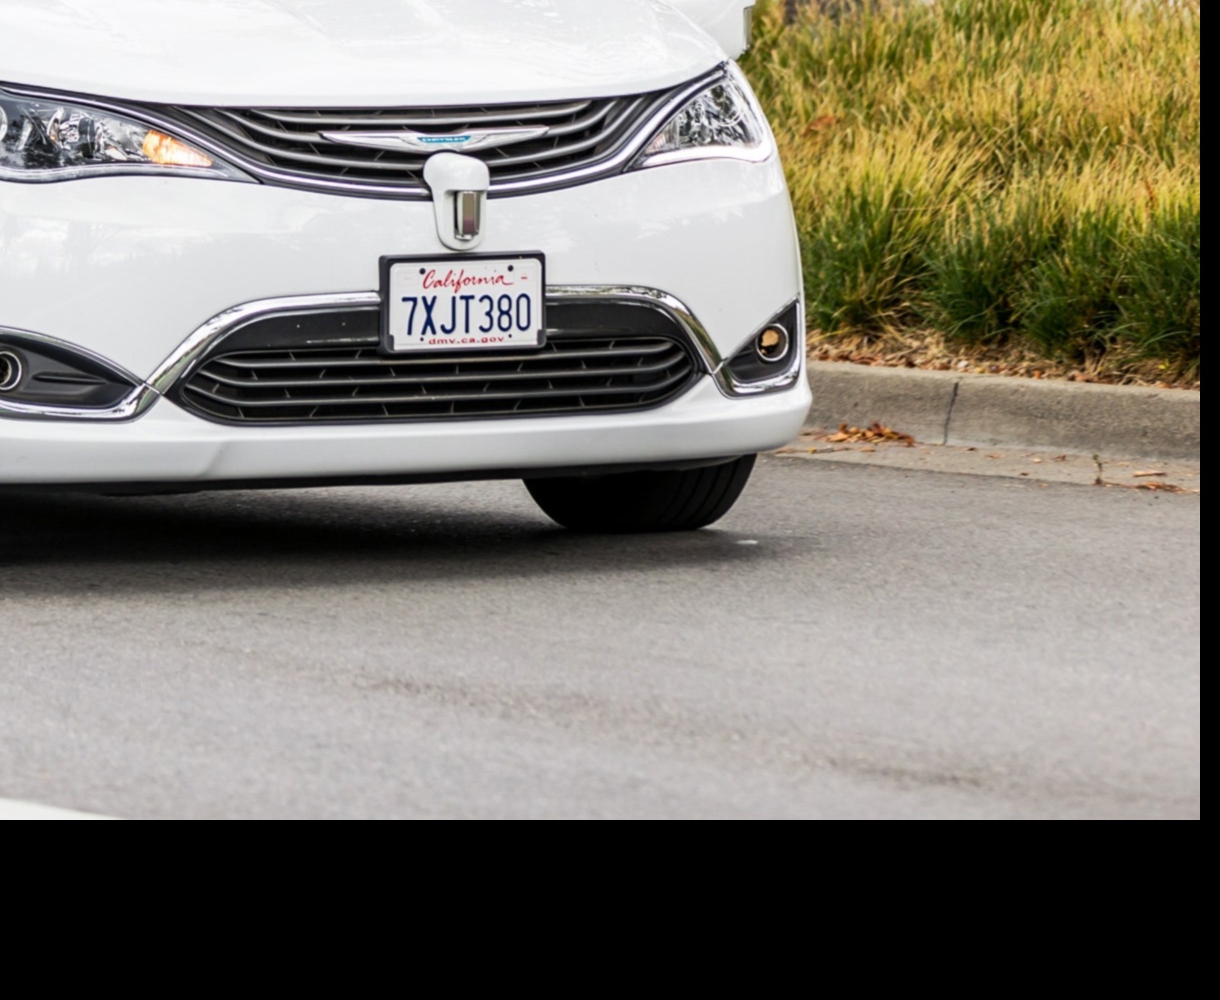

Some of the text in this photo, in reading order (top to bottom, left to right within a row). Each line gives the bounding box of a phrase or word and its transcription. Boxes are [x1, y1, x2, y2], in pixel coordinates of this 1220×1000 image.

[423, 269, 514, 293] California
[401, 293, 531, 335] 7XJT380
[428, 336, 505, 345] dmv.ca.gov
